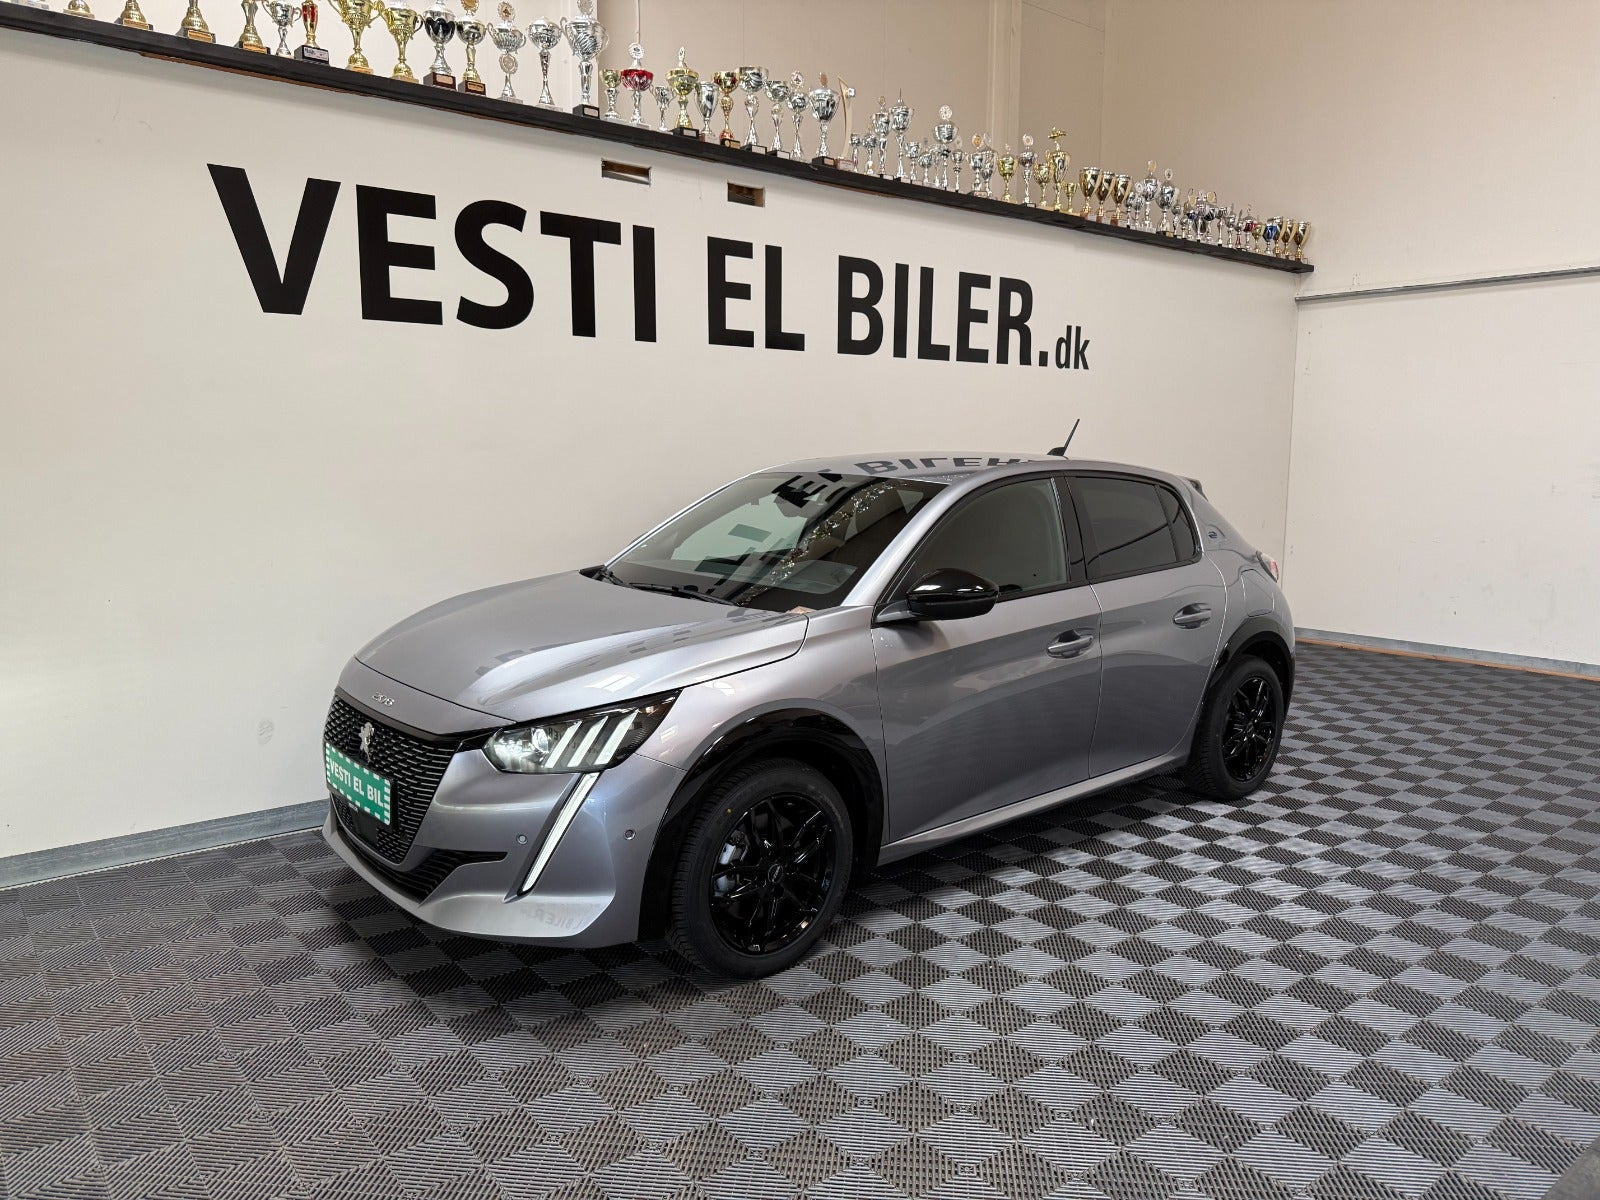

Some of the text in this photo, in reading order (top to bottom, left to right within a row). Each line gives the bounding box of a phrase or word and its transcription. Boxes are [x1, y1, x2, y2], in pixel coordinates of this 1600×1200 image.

[207, 163, 657, 343] VESTI
[707, 235, 805, 352] EL
[329, 758, 352, 788] VESTI
[352, 775, 365, 797] EL
